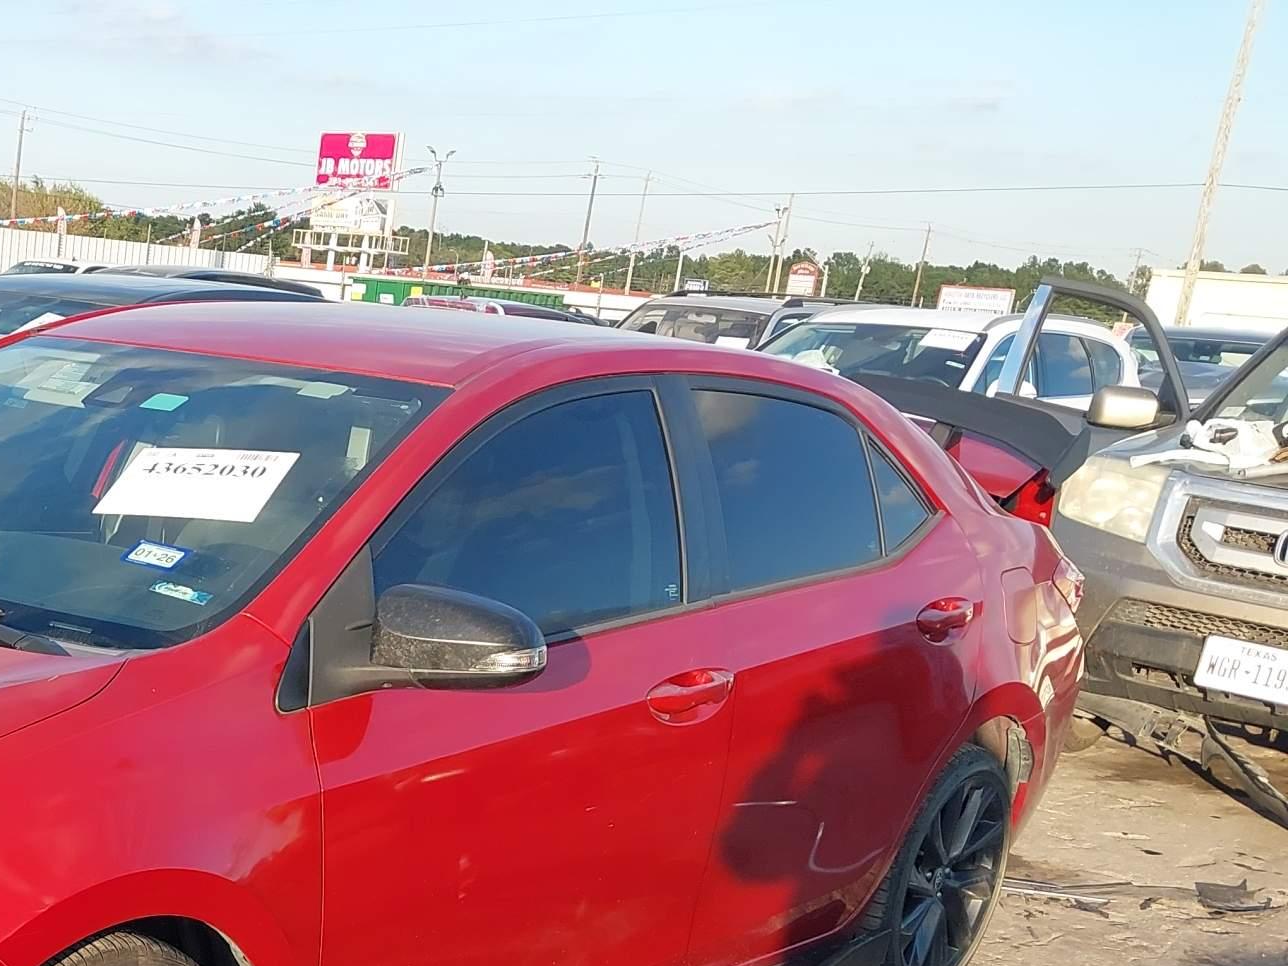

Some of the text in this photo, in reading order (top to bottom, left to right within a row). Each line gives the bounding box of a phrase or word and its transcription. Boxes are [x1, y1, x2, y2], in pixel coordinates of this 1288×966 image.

[318, 157, 392, 177] JB MOTORS
[142, 462, 268, 479] 43652030
[1240, 646, 1278, 662] TEXAS
[1206, 655, 1288, 691] WGR-119
